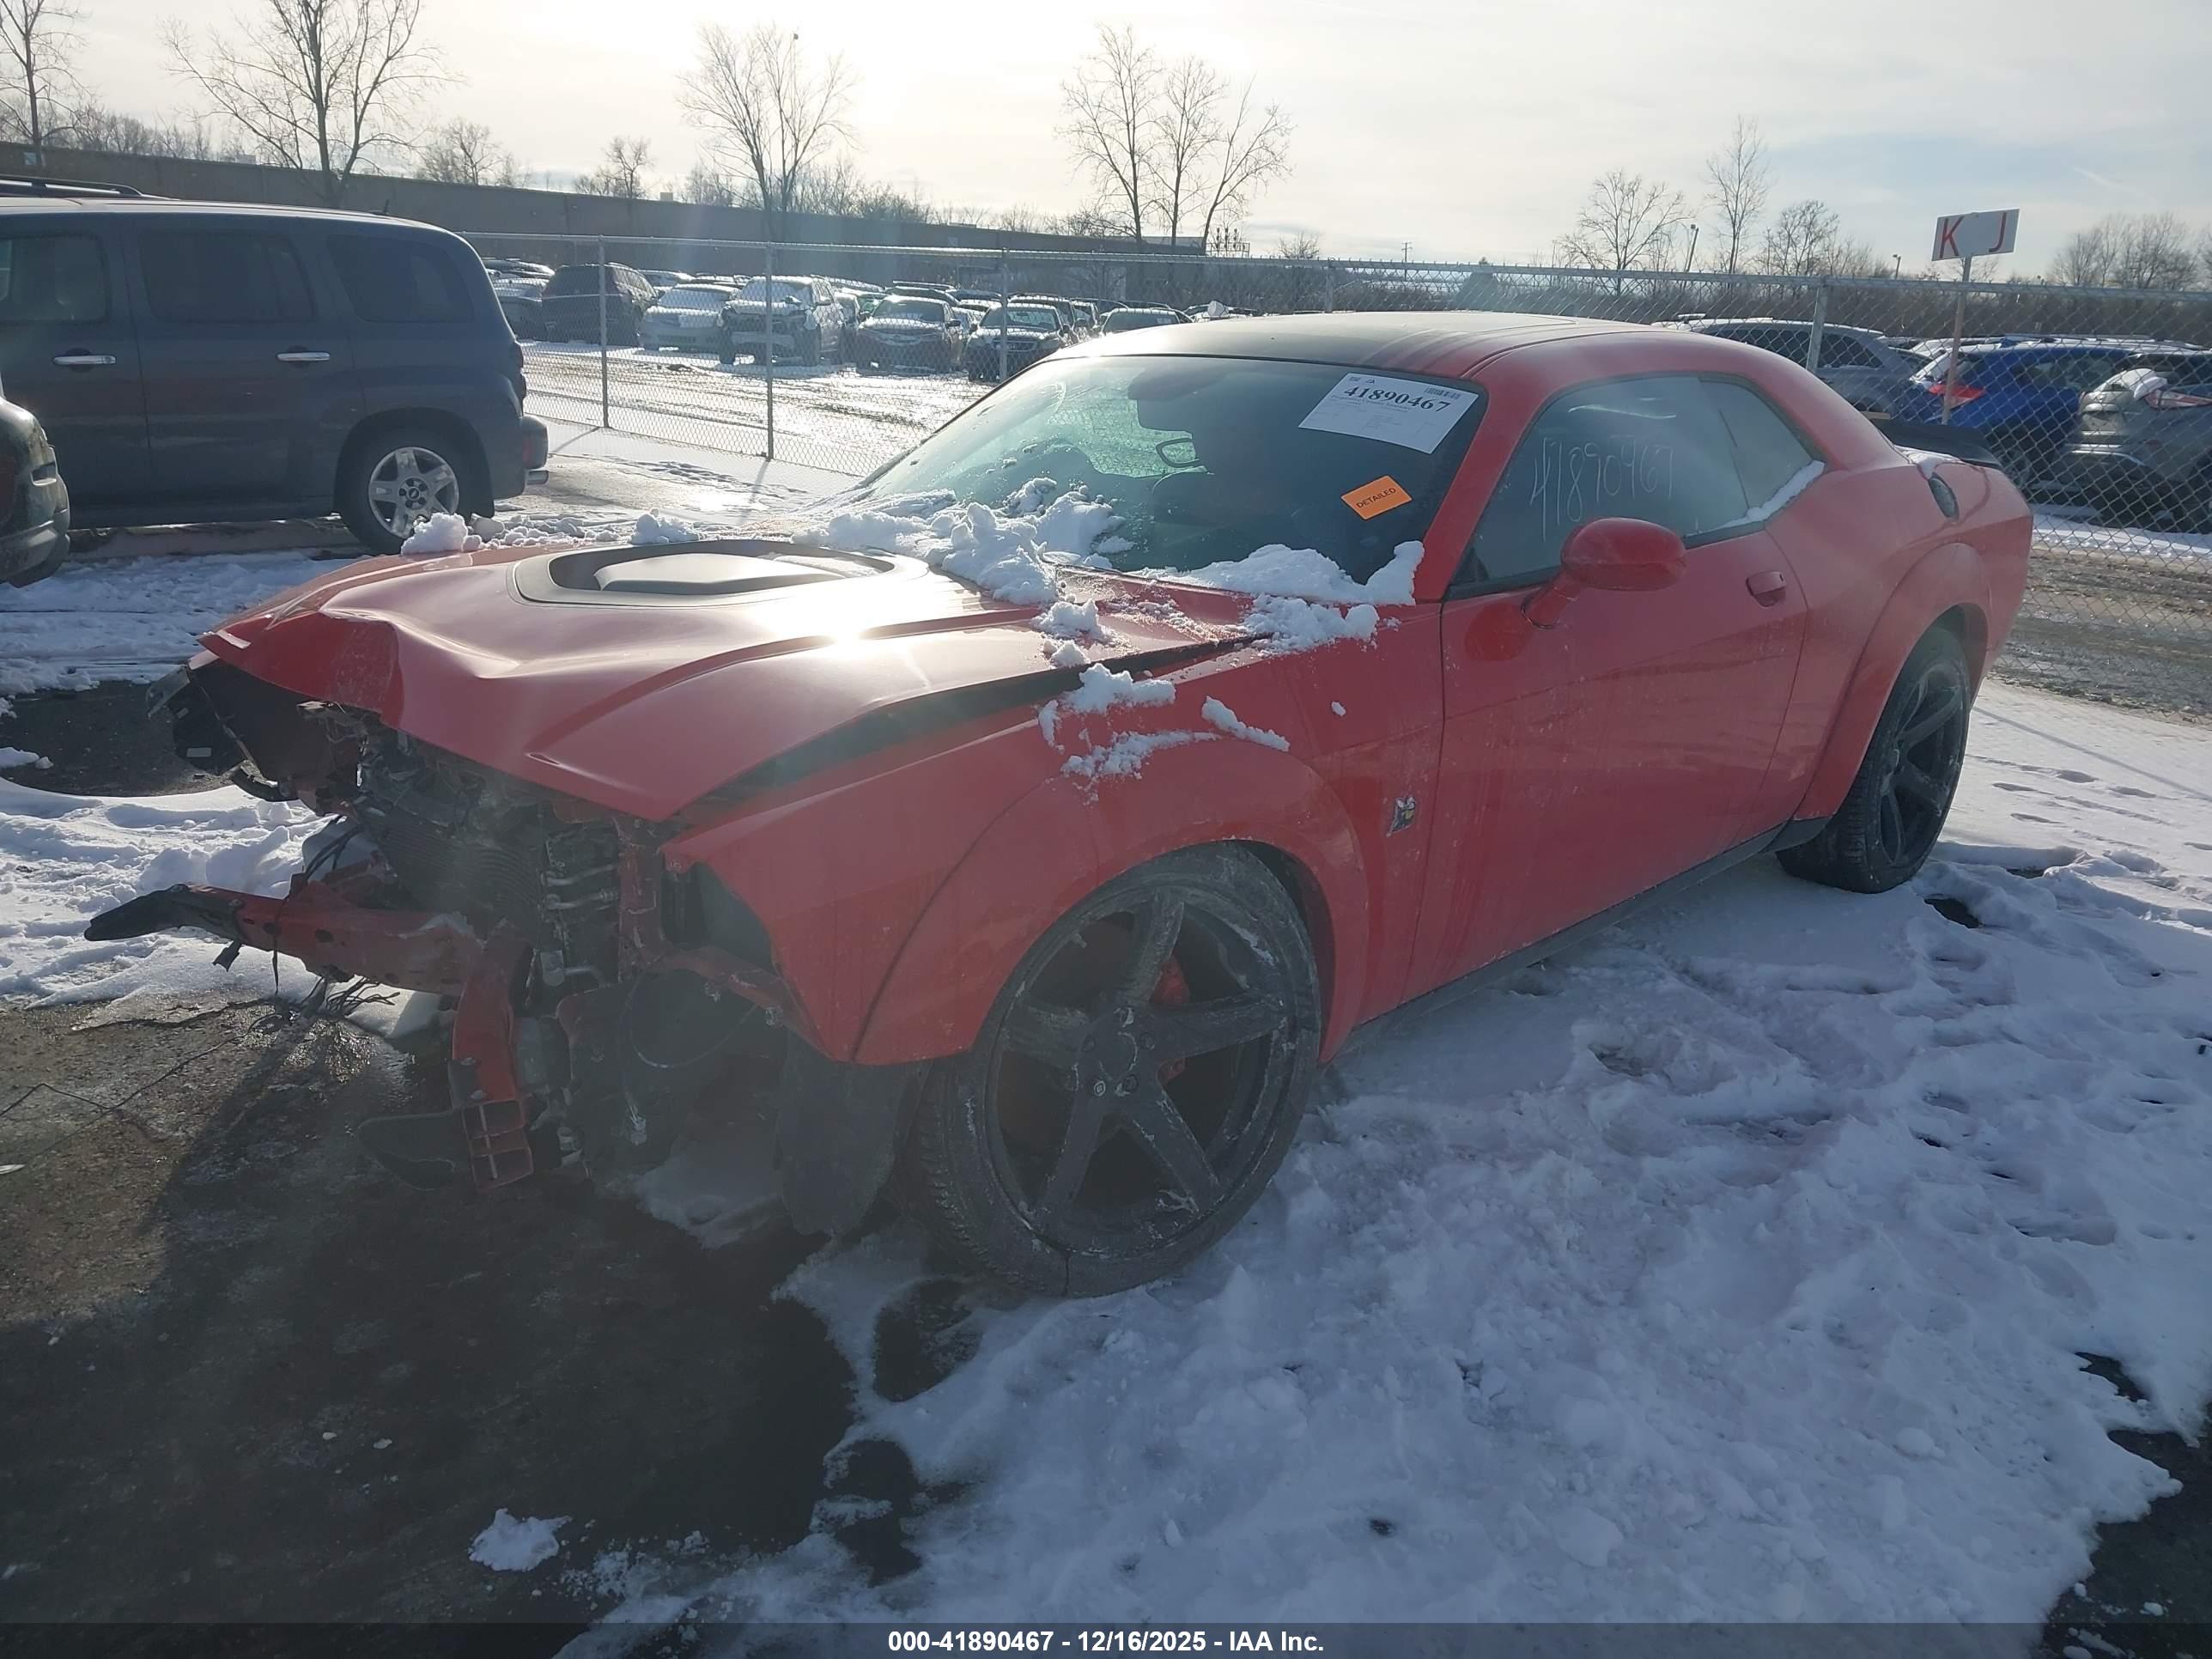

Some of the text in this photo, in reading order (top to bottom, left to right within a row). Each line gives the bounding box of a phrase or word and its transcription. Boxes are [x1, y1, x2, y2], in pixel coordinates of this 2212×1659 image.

[1939, 212, 2007, 258] K J
[1344, 386, 1451, 412] 41890467
[1356, 487, 1396, 508] DETAILED
